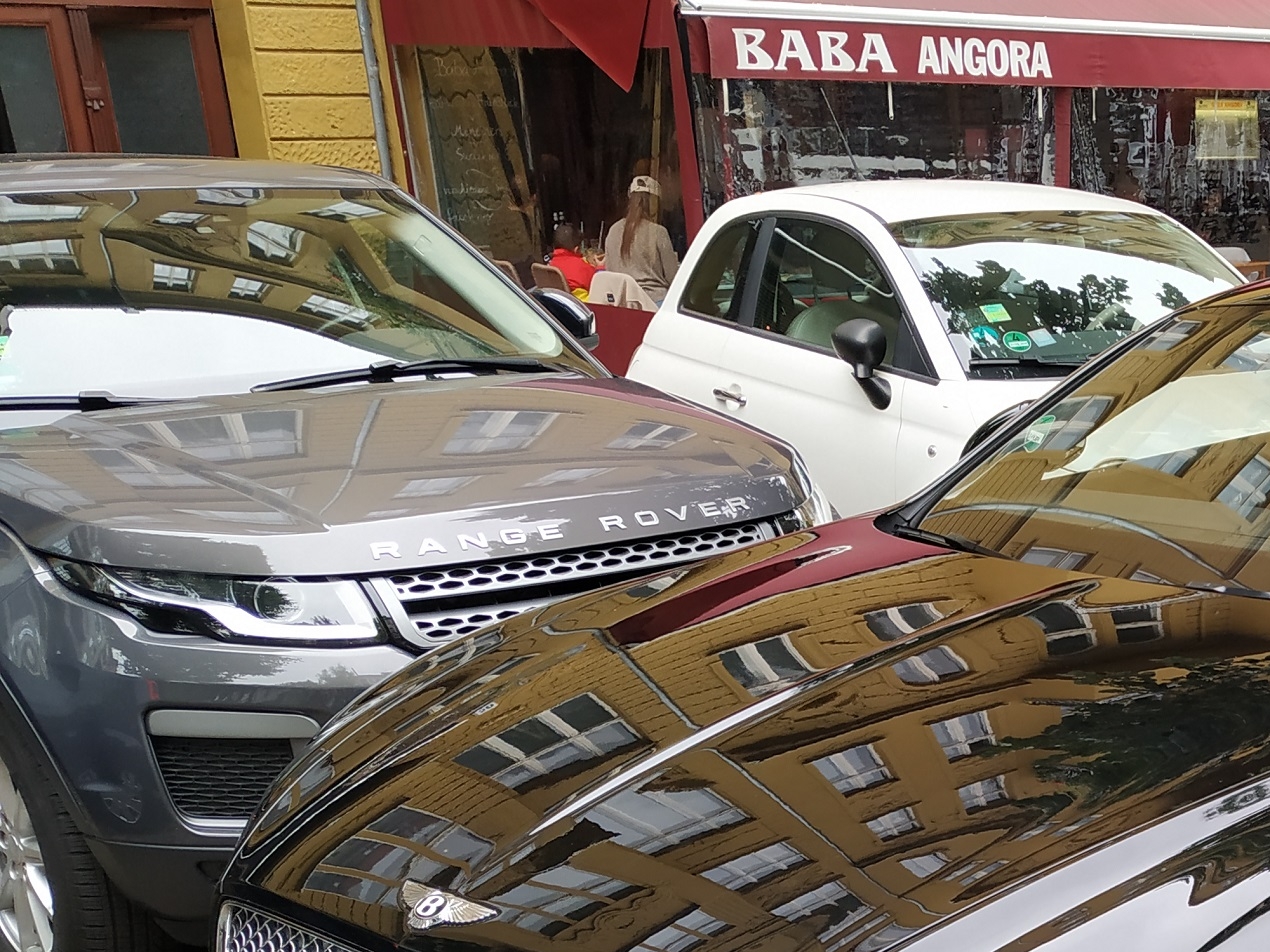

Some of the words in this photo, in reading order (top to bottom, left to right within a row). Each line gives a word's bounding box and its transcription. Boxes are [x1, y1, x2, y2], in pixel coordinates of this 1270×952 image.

[731, 27, 898, 74] BABA
[917, 35, 1053, 78] ANGORA
[369, 523, 564, 560] RANGE
[598, 496, 752, 532] ROVER
